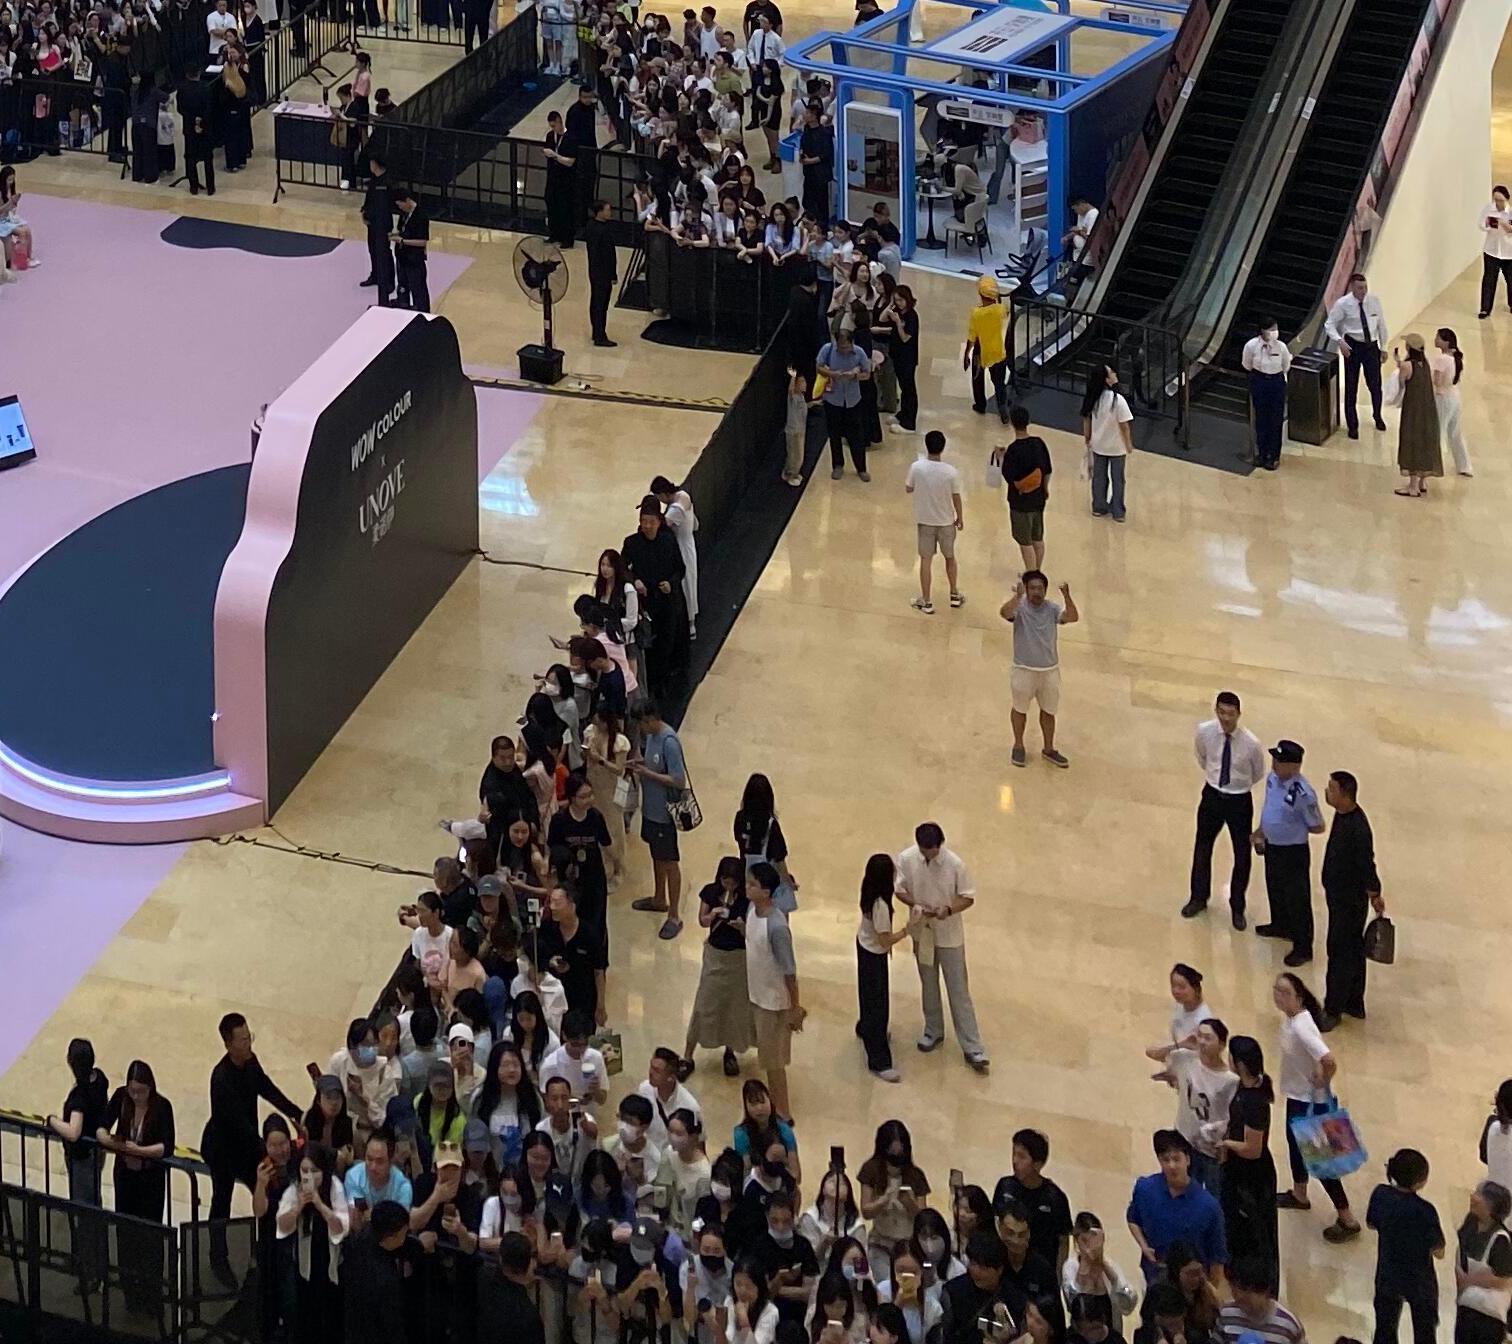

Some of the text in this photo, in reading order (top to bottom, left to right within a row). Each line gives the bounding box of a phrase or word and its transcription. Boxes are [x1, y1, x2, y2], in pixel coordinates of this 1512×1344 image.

[350, 390, 412, 472] WOW COLOUR
[359, 458, 406, 534] UNOVE
